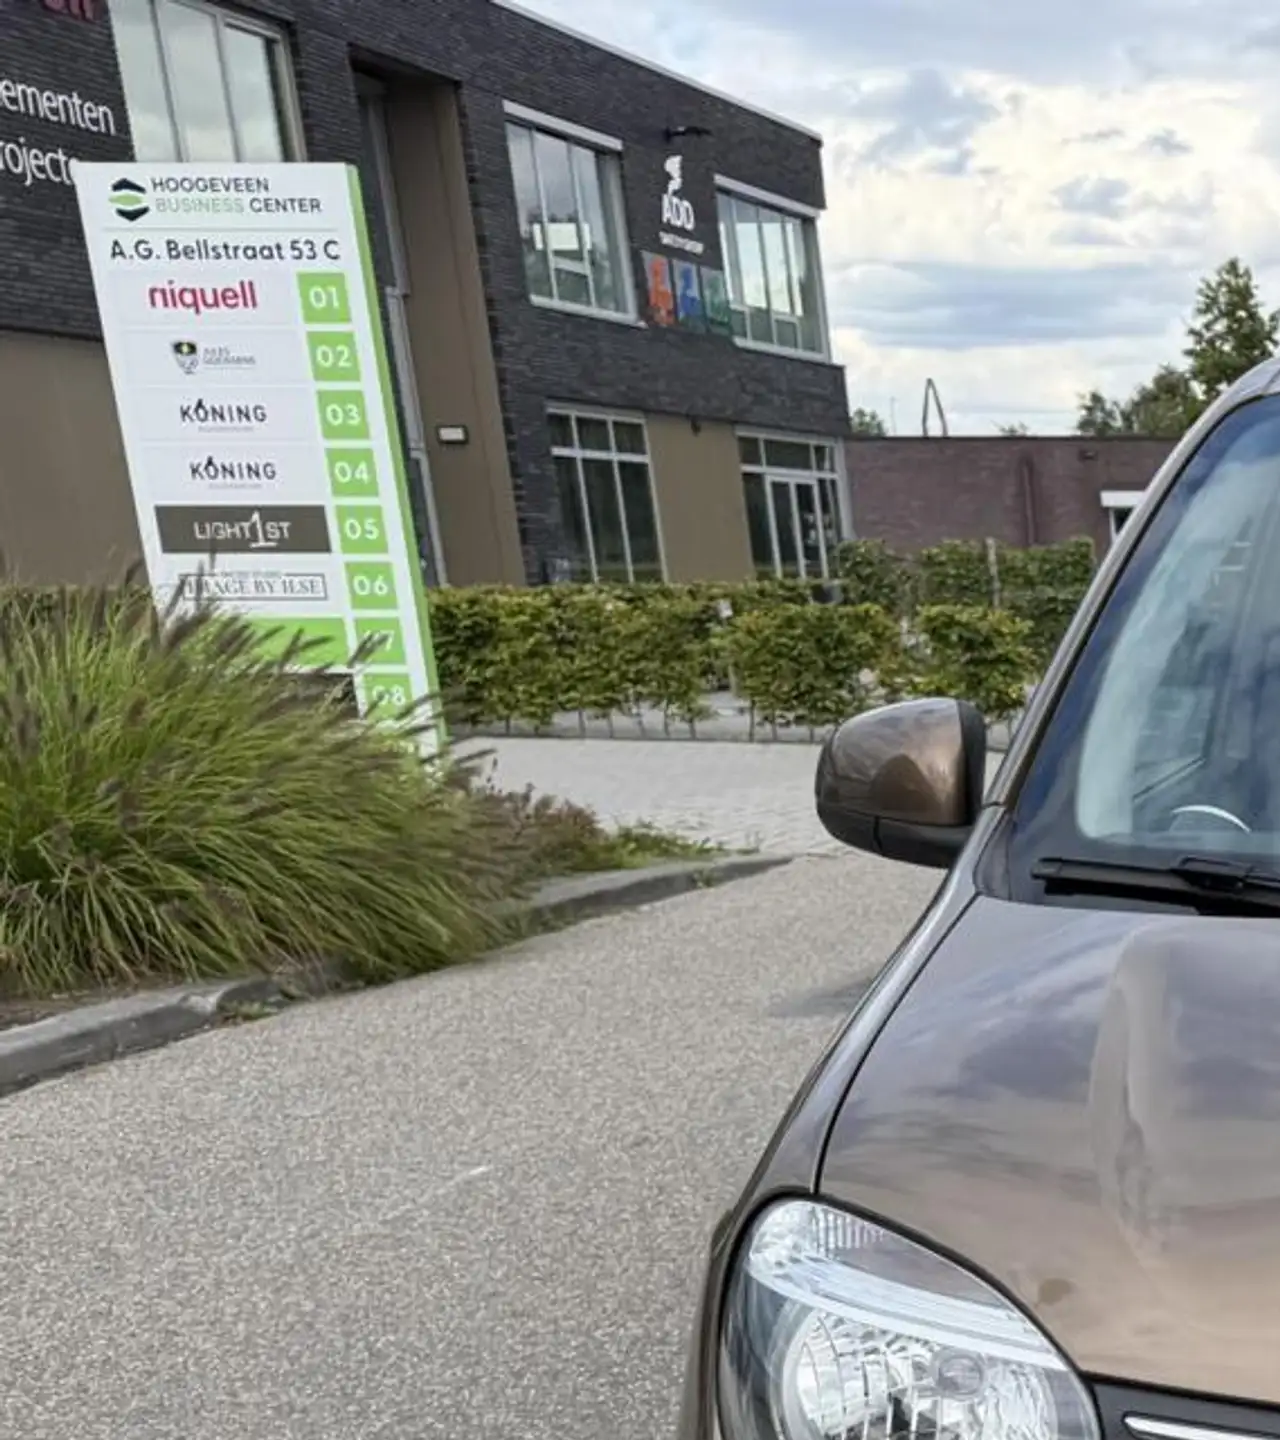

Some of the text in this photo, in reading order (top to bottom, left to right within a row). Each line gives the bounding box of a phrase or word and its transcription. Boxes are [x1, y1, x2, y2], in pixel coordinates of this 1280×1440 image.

[0, 136, 78, 187] roject
[151, 177, 270, 193] HOOGEVEEN
[155, 198, 322, 213] BUSINESS CENTER
[661, 193, 695, 231] ADD
[110, 238, 341, 260] A.G. Bellstraat 53 C
[148, 279, 259, 315] niquell
[308, 286, 340, 309] 01
[316, 344, 352, 368] 02
[325, 403, 361, 425] 03
[334, 461, 370, 483] 04
[344, 519, 380, 540] 05
[253, 578, 277, 595] BY
[353, 573, 388, 595] 06
